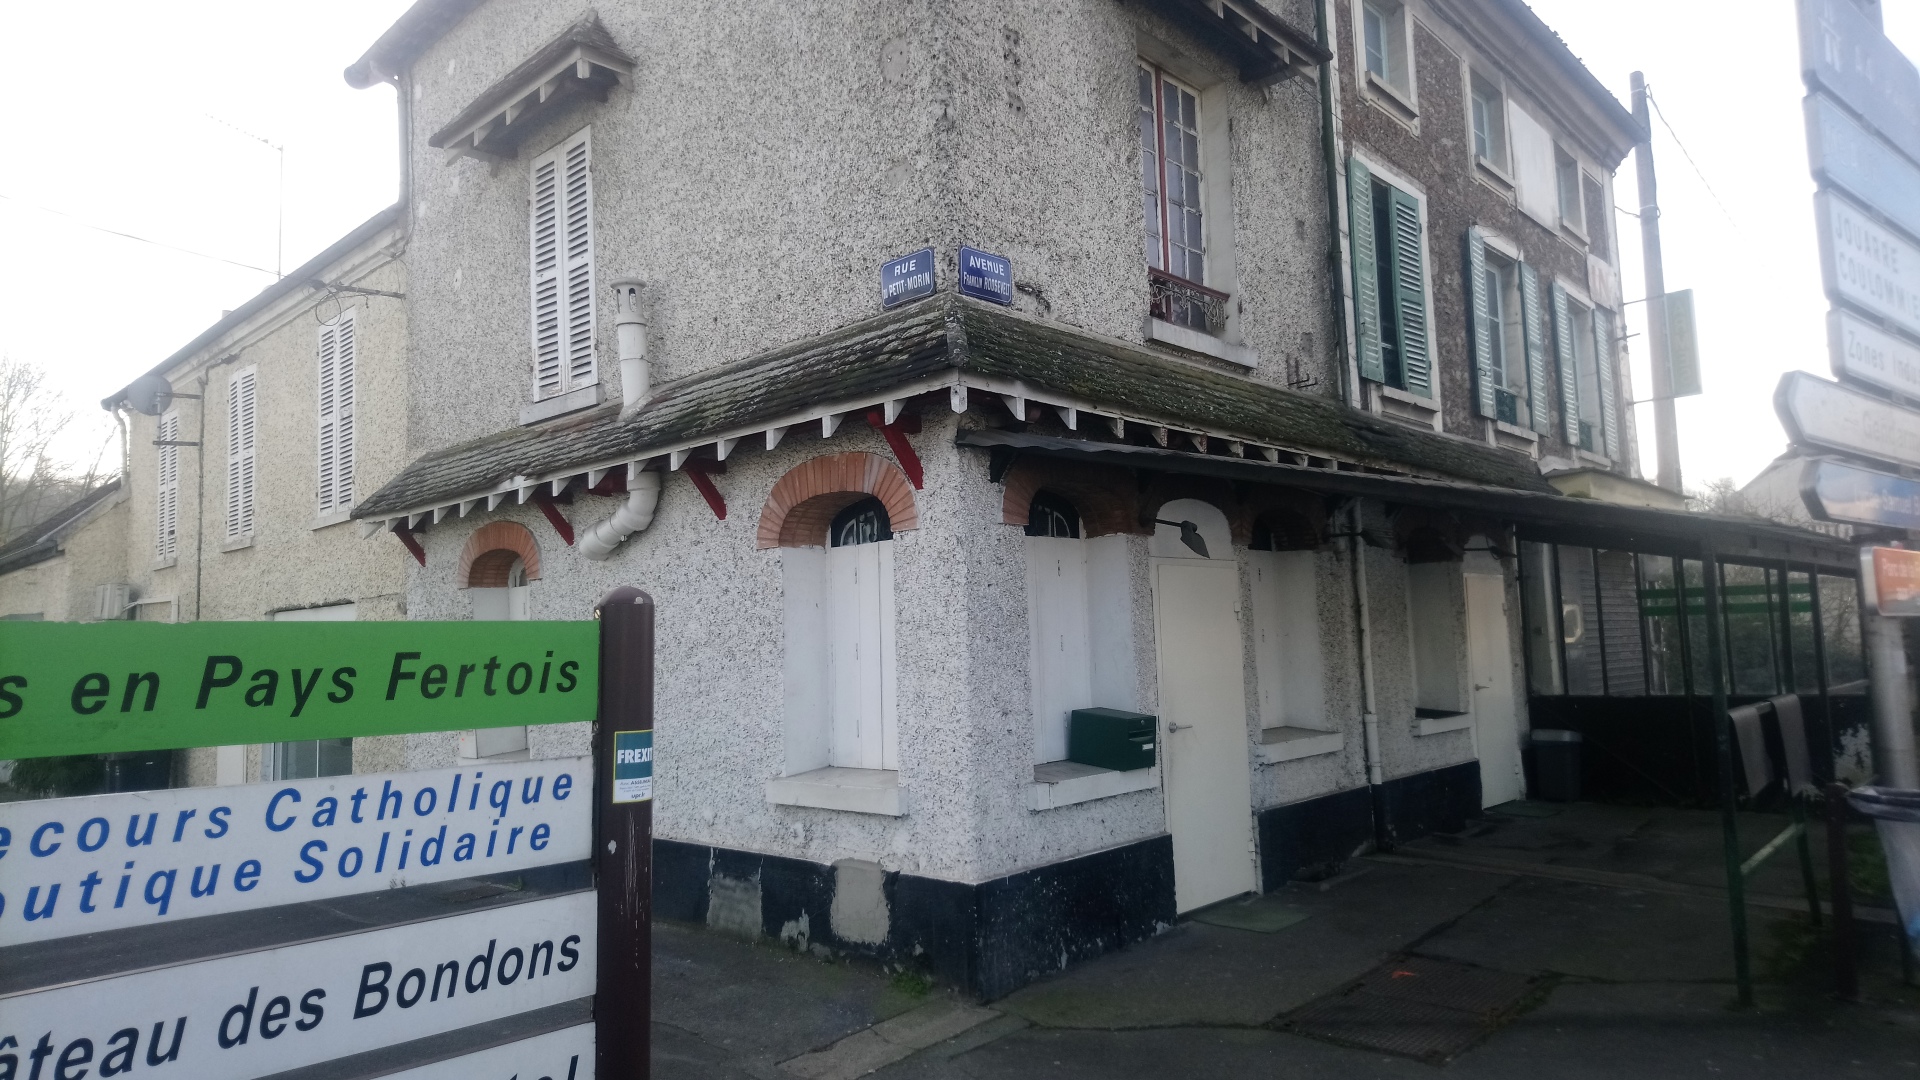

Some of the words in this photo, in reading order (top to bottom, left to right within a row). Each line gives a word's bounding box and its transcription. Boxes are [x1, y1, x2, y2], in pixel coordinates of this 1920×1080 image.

[894, 259, 917, 277] RUE
[969, 255, 1005, 276] AVENUE
[983, 276, 1010, 296] ROOSEVELT
[1847, 329, 1885, 372] Zones
[70, 671, 160, 715] en
[195, 655, 357, 718] Pays
[385, 651, 580, 701] Fertois
[617, 747, 653, 764] FREXIT
[265, 771, 573, 832] Catholique
[0, 859, 262, 922] utique
[294, 819, 551, 884] Solidaire
[217, 986, 327, 1050] des
[353, 934, 581, 1020] Bondons
